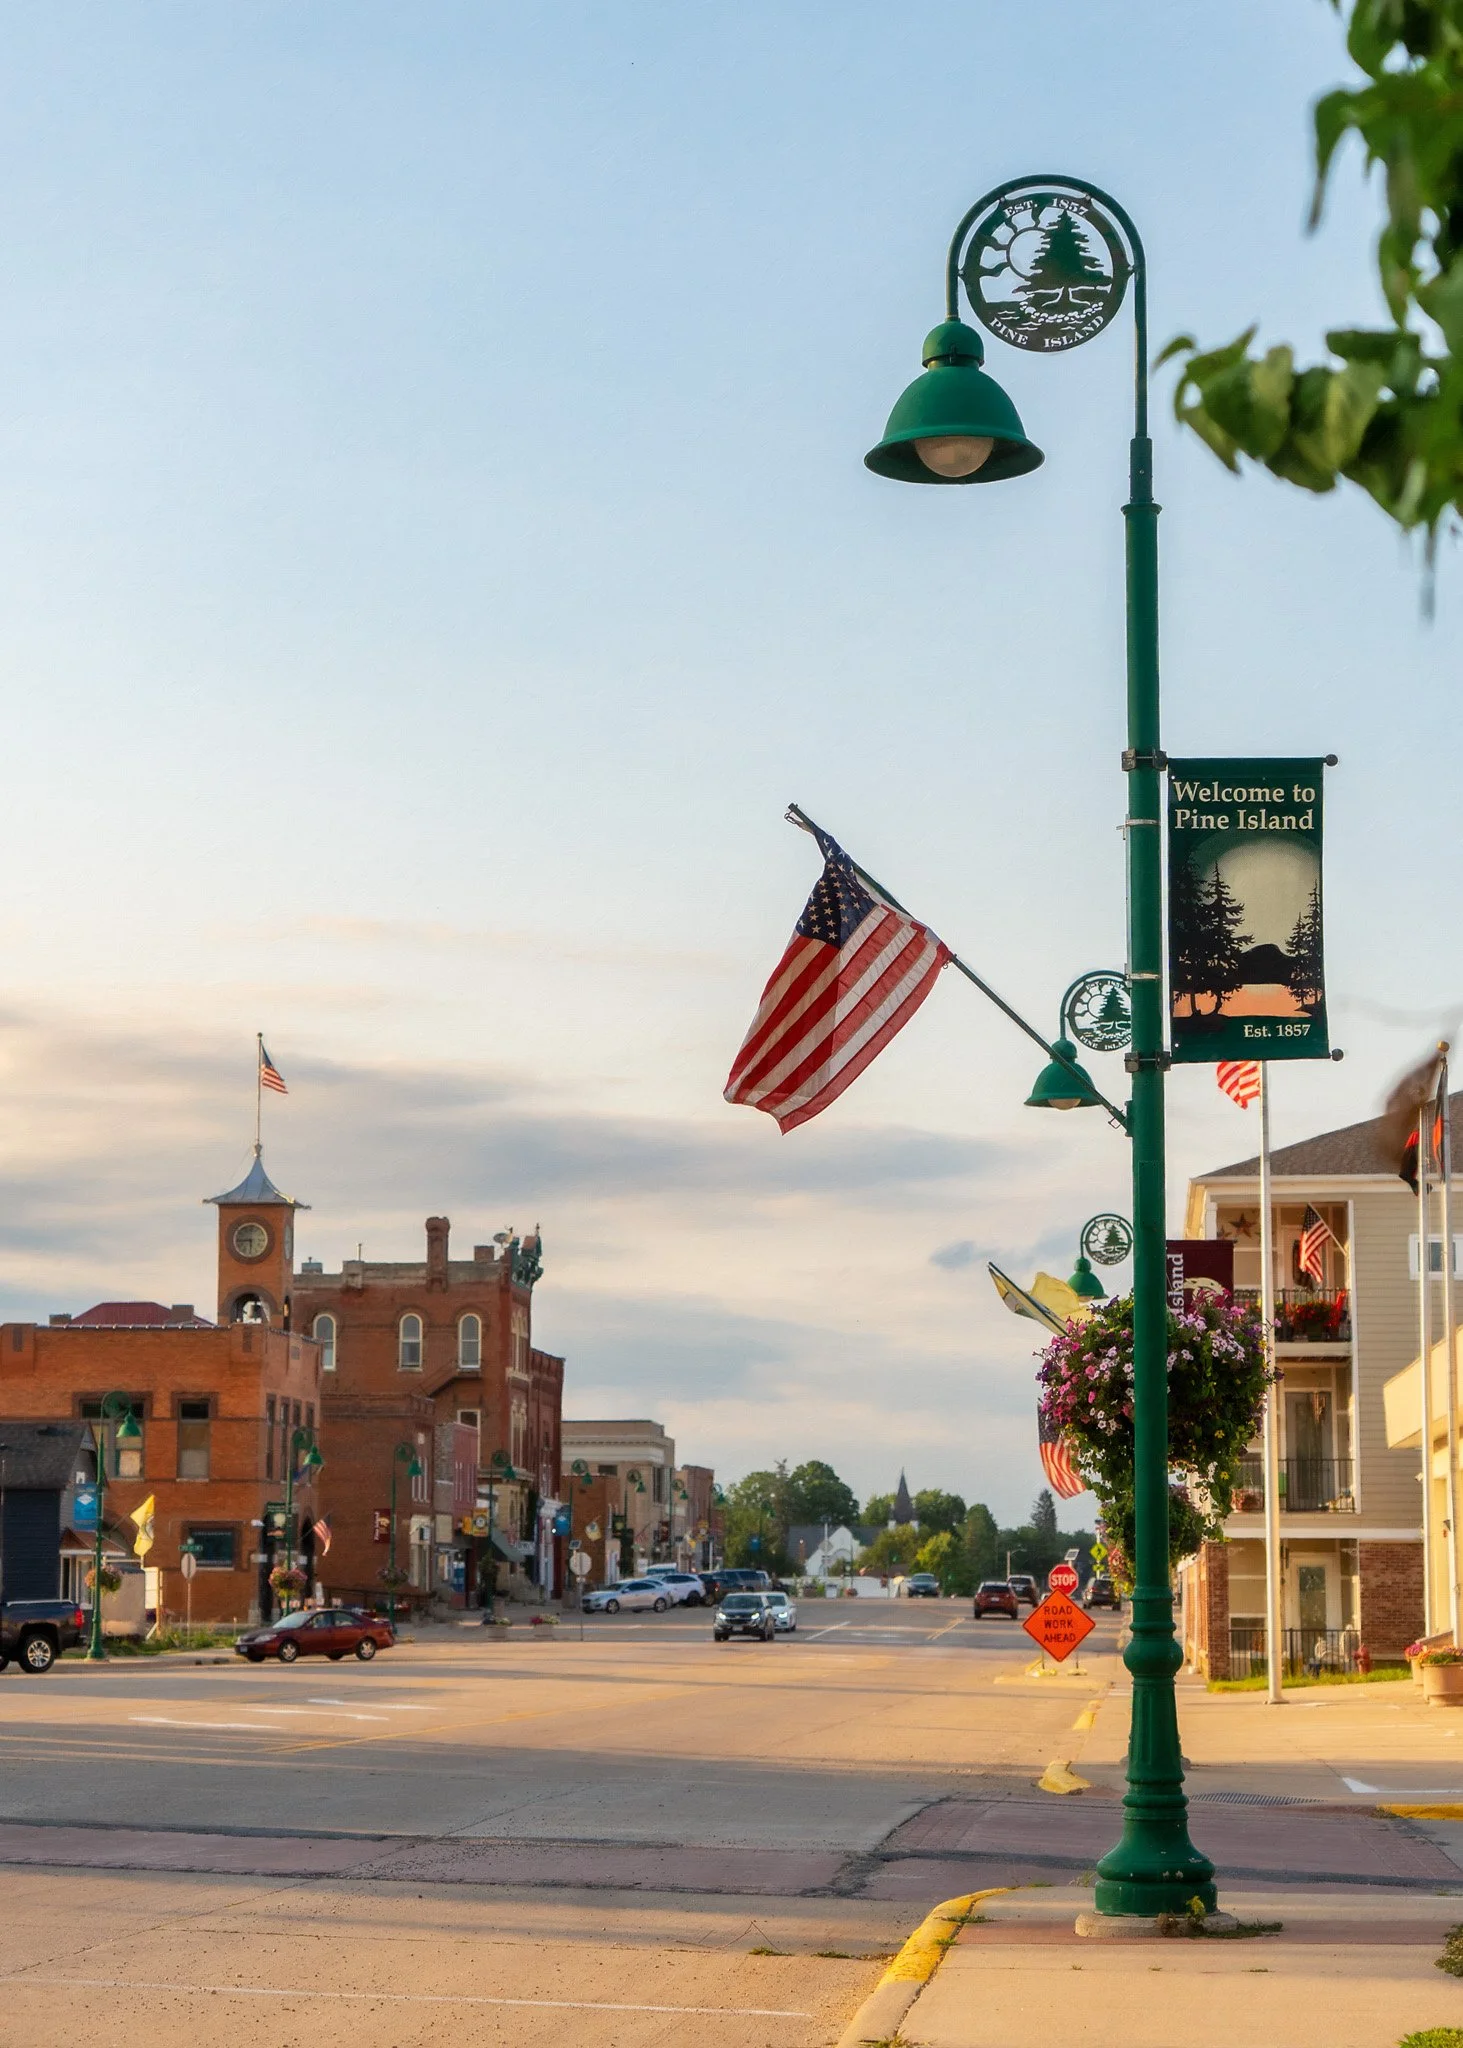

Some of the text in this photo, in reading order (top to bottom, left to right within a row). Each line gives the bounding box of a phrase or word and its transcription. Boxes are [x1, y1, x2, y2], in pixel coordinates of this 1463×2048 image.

[1003, 197, 1089, 219] EST. 1857
[988, 314, 1105, 348] PINE ISLAND
[1173, 781, 1316, 803] Welcome to
[1174, 808, 1315, 830] Pine Island
[1243, 1024, 1311, 1038] Est. 1857
[1051, 1574, 1075, 1586] STOP
[1044, 1606, 1073, 1615] ROAD
[1044, 1619, 1073, 1629] WORK
[1043, 1634, 1076, 1643] AHEAD
